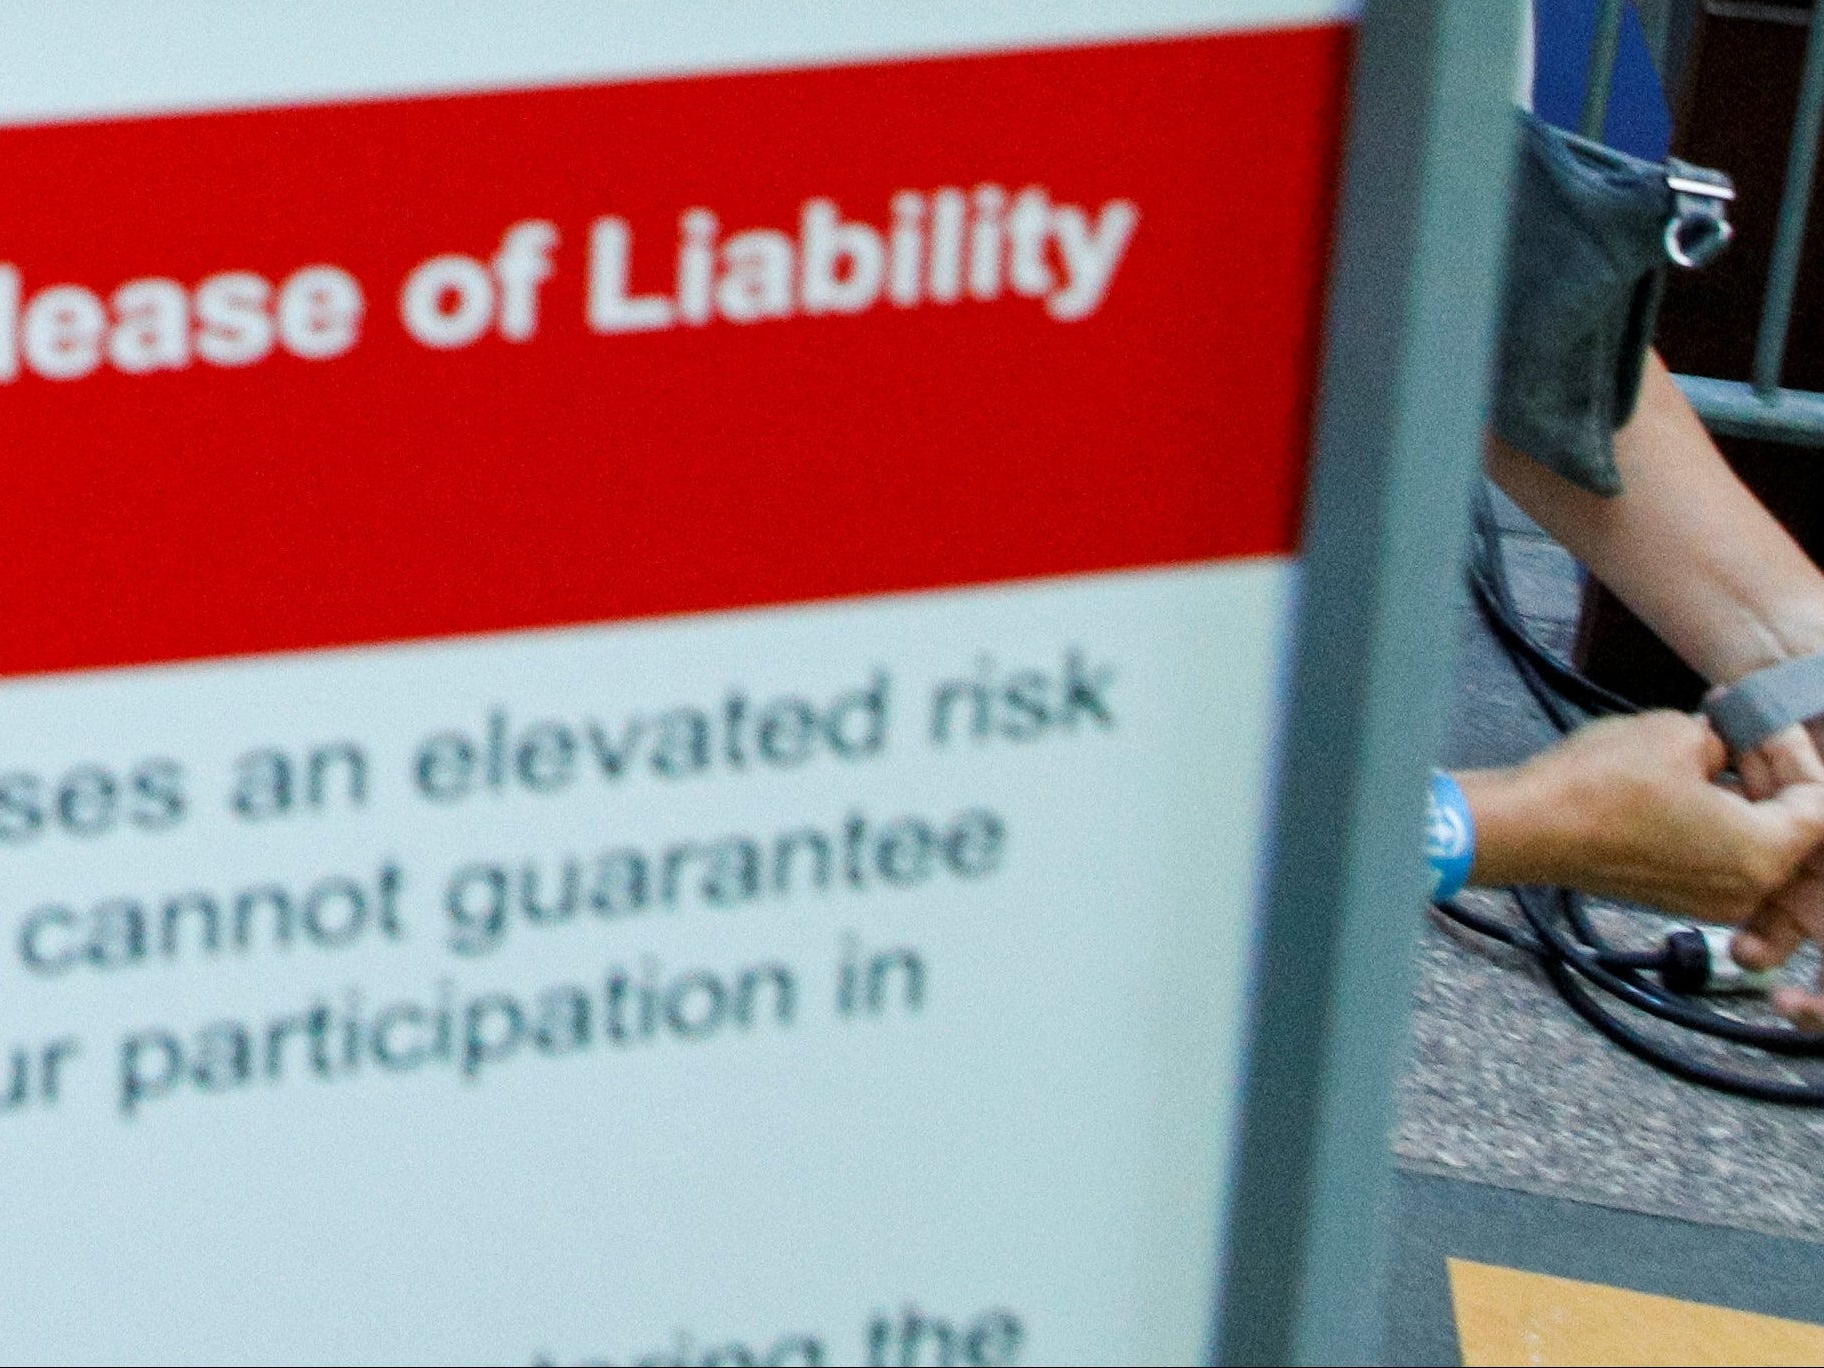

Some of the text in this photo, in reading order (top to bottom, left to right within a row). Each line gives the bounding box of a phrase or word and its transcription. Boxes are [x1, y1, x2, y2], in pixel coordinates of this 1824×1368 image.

[400, 219, 557, 349] of
[586, 184, 1137, 333] Liability
[228, 736, 369, 822] an
[411, 672, 888, 802] elevated
[928, 649, 1115, 745] risk
[16, 862, 404, 976] cannot
[444, 806, 1009, 957] guarantee
[116, 962, 798, 1119] participation
[834, 934, 929, 1018] in
